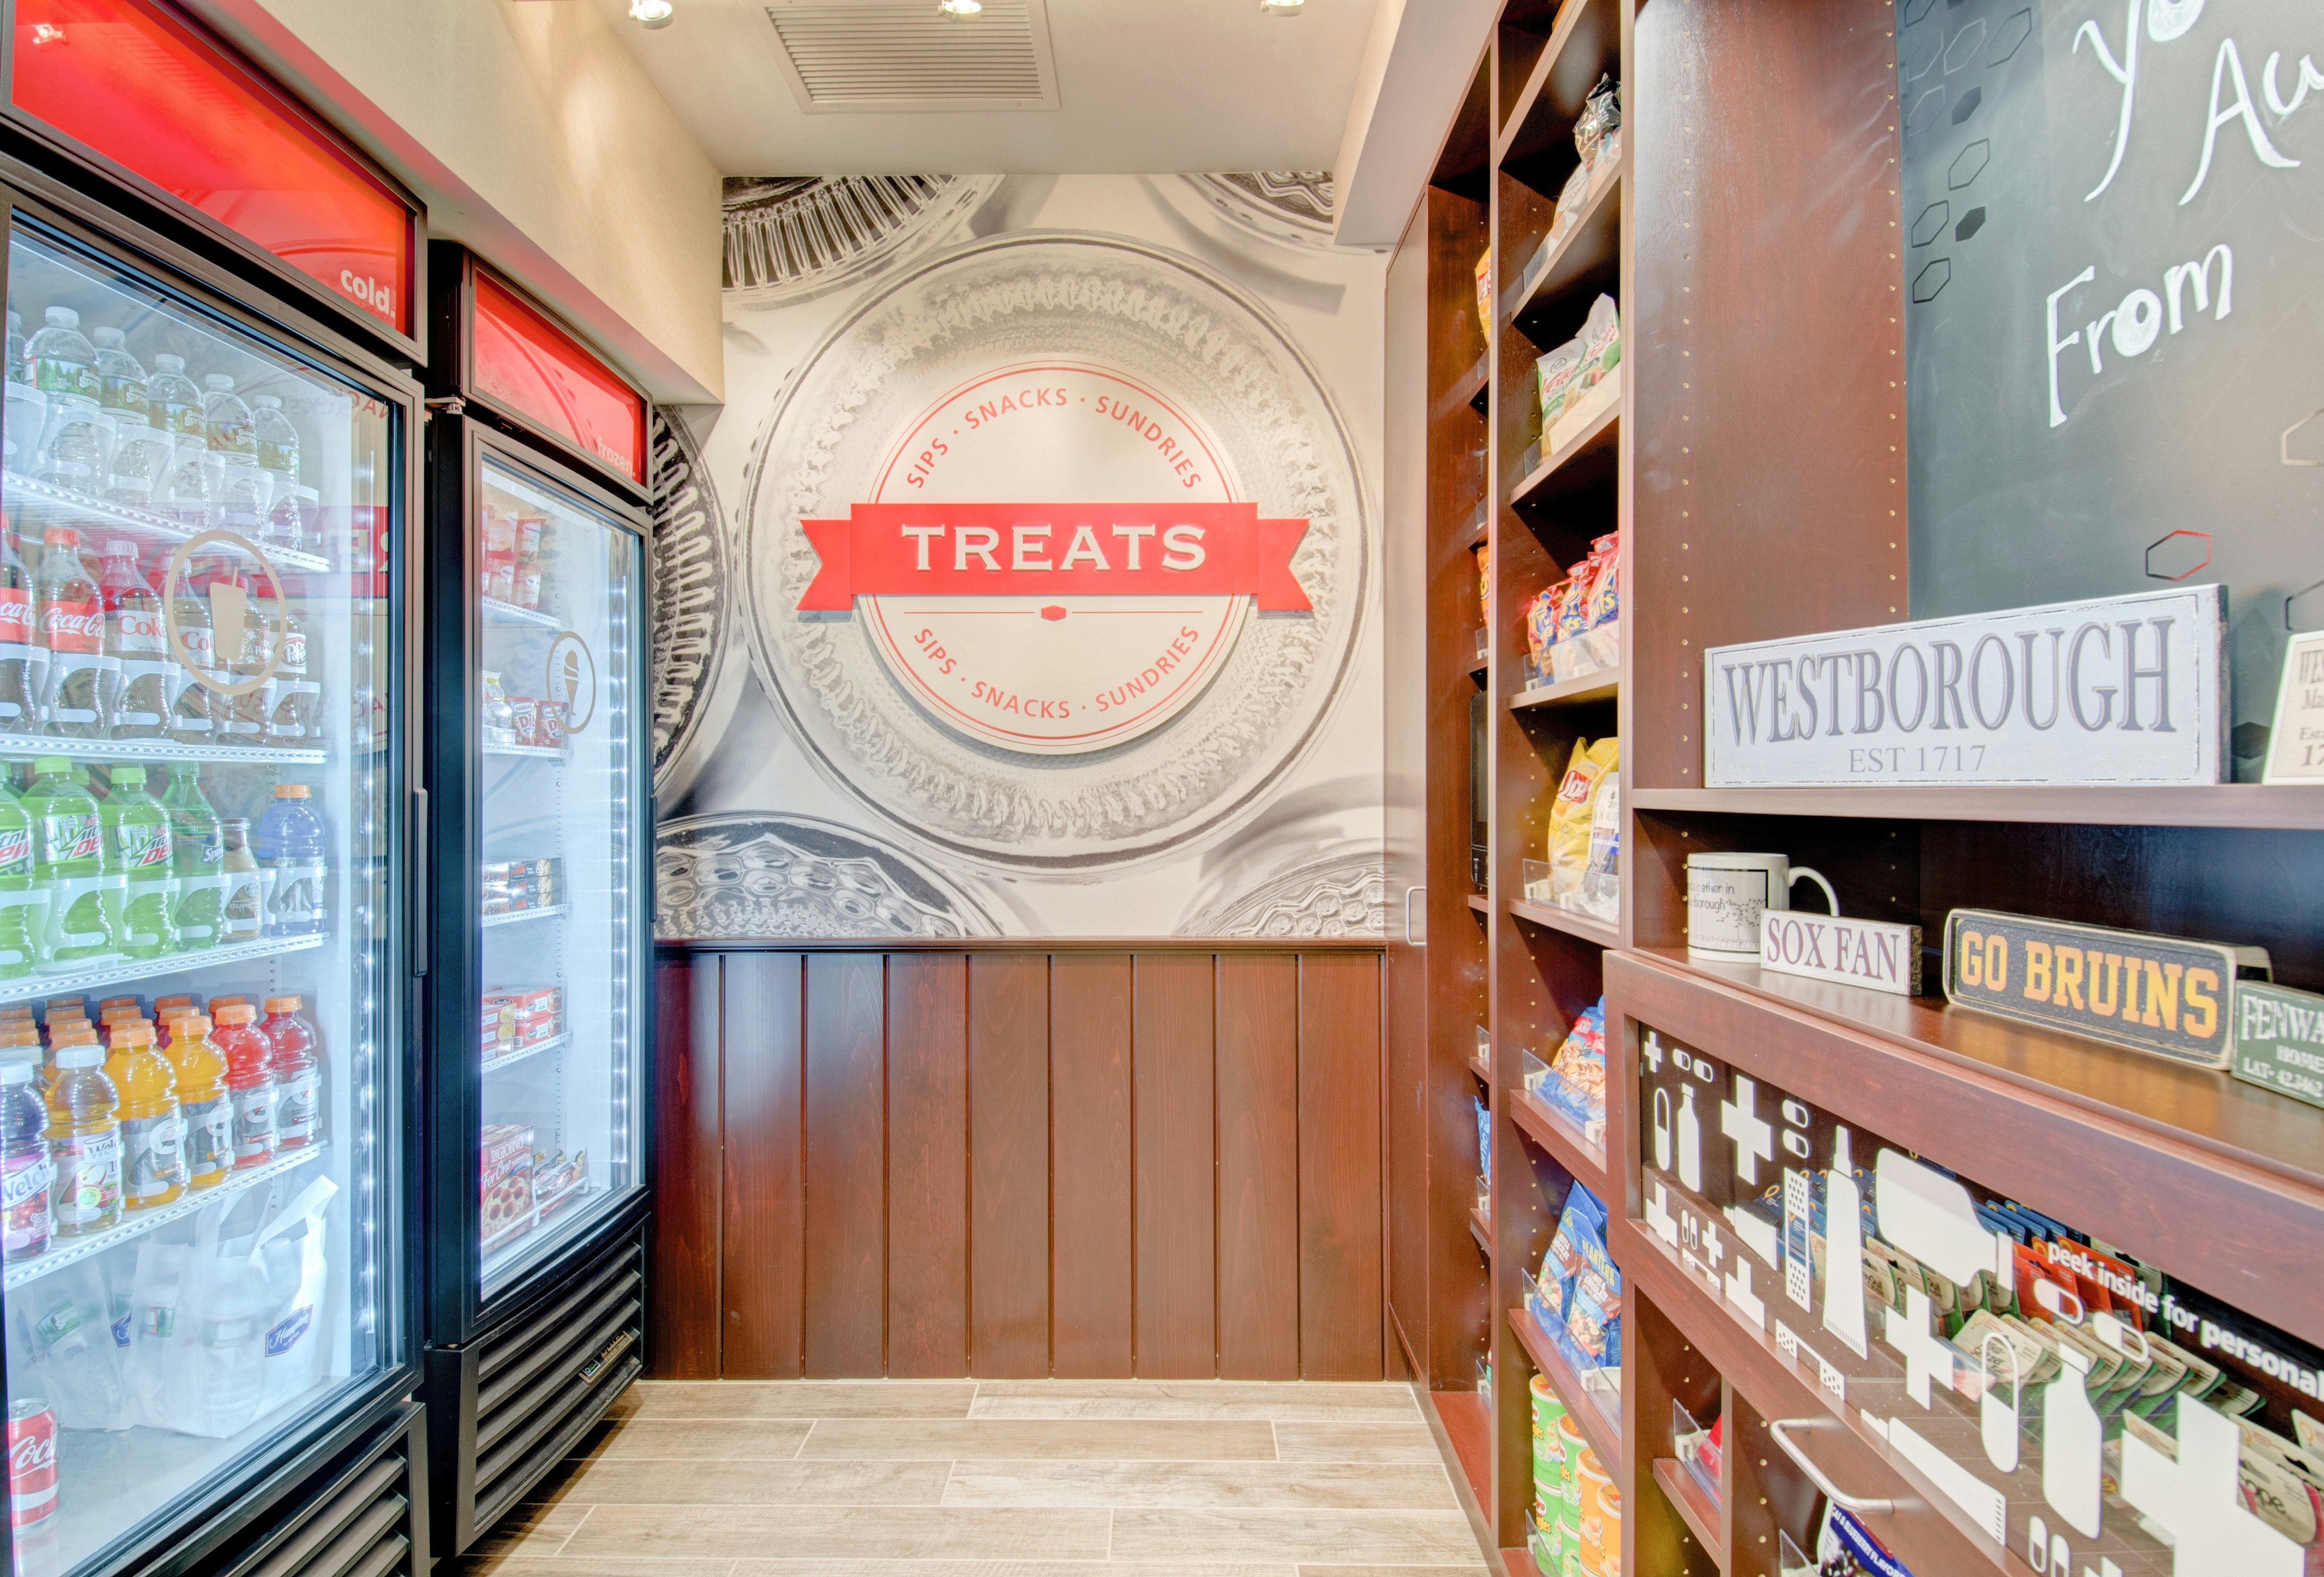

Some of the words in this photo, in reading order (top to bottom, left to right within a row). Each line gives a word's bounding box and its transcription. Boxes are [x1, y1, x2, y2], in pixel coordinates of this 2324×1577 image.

[341, 270, 395, 319] cold.
[2047, 244, 2233, 428] From
[597, 436, 636, 477] frozen.
[906, 438, 949, 489] SIPS
[964, 388, 1067, 430] SNACKS
[1095, 395, 1201, 489] SUNDRIES
[902, 524, 1206, 572] TREATS
[913, 628, 957, 676] SIPS
[971, 680, 1070, 719] SNACKS
[1096, 625, 1199, 713] SUNDRIES
[1722, 617, 2177, 747] WESTBOROUGH
[1848, 747, 1905, 773] EST
[1917, 744, 1987, 773] 1717
[1726, 883, 1735, 894] in
[1767, 917, 1827, 969] SOX
[1834, 926, 1900, 984] FAN
[1961, 931, 2009, 992] GO
[2023, 940, 2219, 1039] BRUINS
[1582, 1238, 1616, 1287] PLANTERS
[1584, 1275, 1608, 1302] CHOCOLATE
[2048, 1241, 2095, 1281] peek
[2097, 1262, 2160, 1313] inside
[2160, 1294, 2201, 1333] for
[2200, 1318, 2324, 1404] personal
[1843, 1520, 1874, 1556] BLUEBERRY
